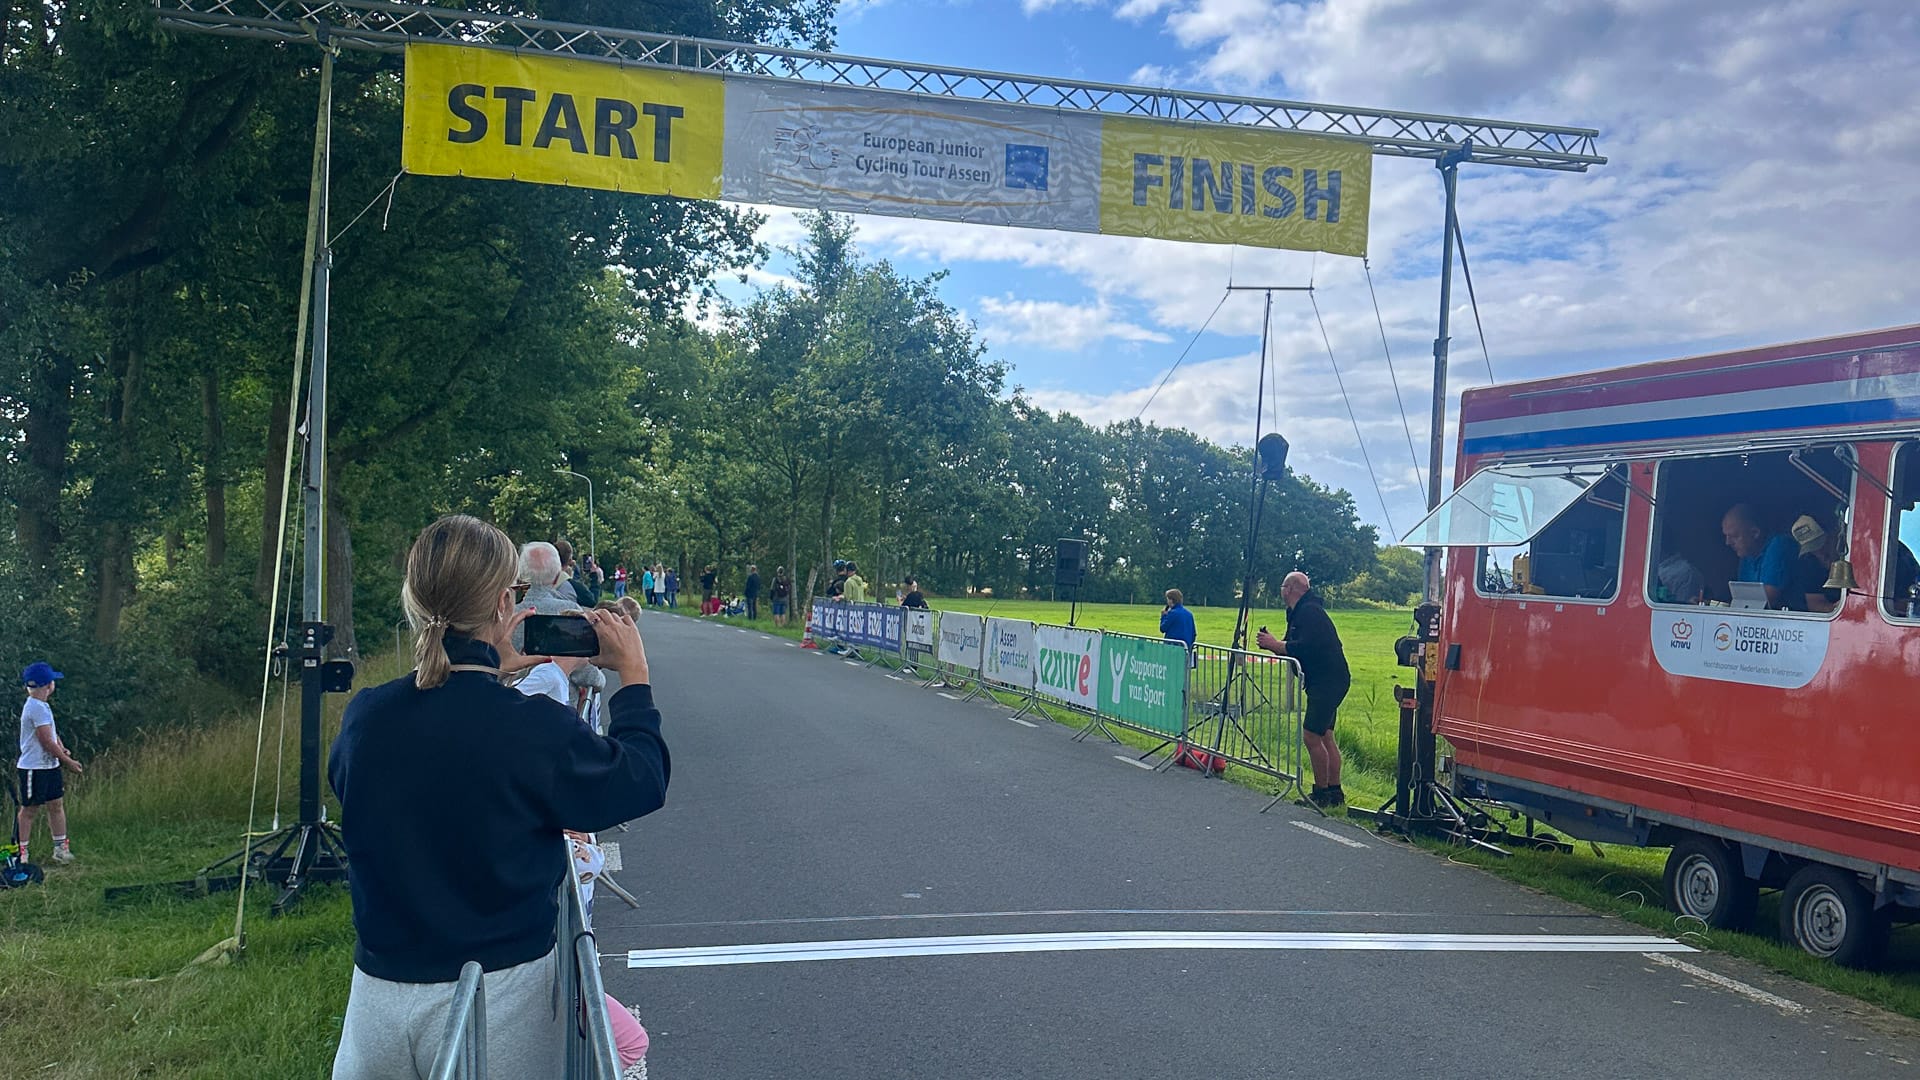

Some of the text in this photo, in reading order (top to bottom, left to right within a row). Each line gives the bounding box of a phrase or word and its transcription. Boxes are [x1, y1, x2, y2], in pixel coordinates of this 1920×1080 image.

[448, 83, 684, 163] START
[863, 132, 985, 160] European Junior
[855, 155, 990, 183] Cycling Tour Assen
[1133, 152, 1342, 223] FINISH
[1000, 628, 1017, 648] Assen
[1735, 626, 1804, 643] NEDERLANDSE
[1735, 639, 1779, 655] LOTERIJ
[1000, 650, 1029, 670] sportstad
[1039, 638, 1092, 697] univé
[1129, 655, 1168, 681] Supporter
[1128, 684, 1166, 709] van Sport
